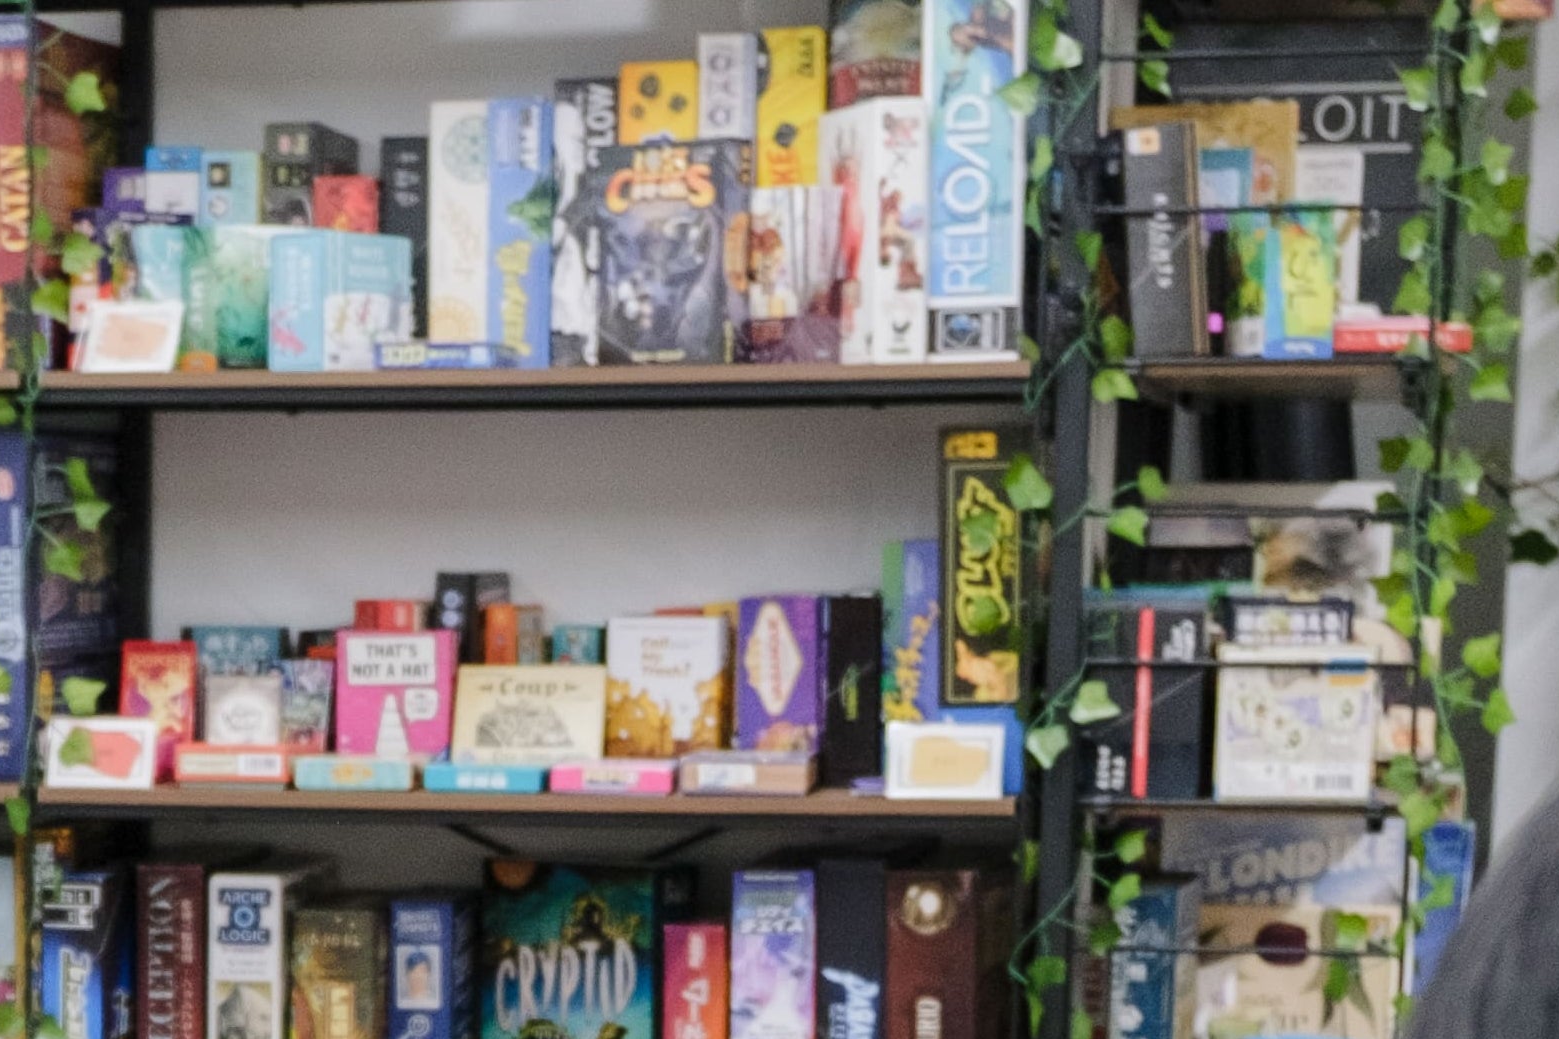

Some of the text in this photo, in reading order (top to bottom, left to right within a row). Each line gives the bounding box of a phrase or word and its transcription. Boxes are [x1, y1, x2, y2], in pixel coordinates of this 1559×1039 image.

[364, 643, 419, 660] THAT'S
[352, 663, 430, 680] NOT A HAT
[499, 678, 560, 699] Coup
[221, 890, 270, 905] ARCHE
[219, 929, 268, 943] LOGIC
[495, 937, 636, 1032] CRYPTID
